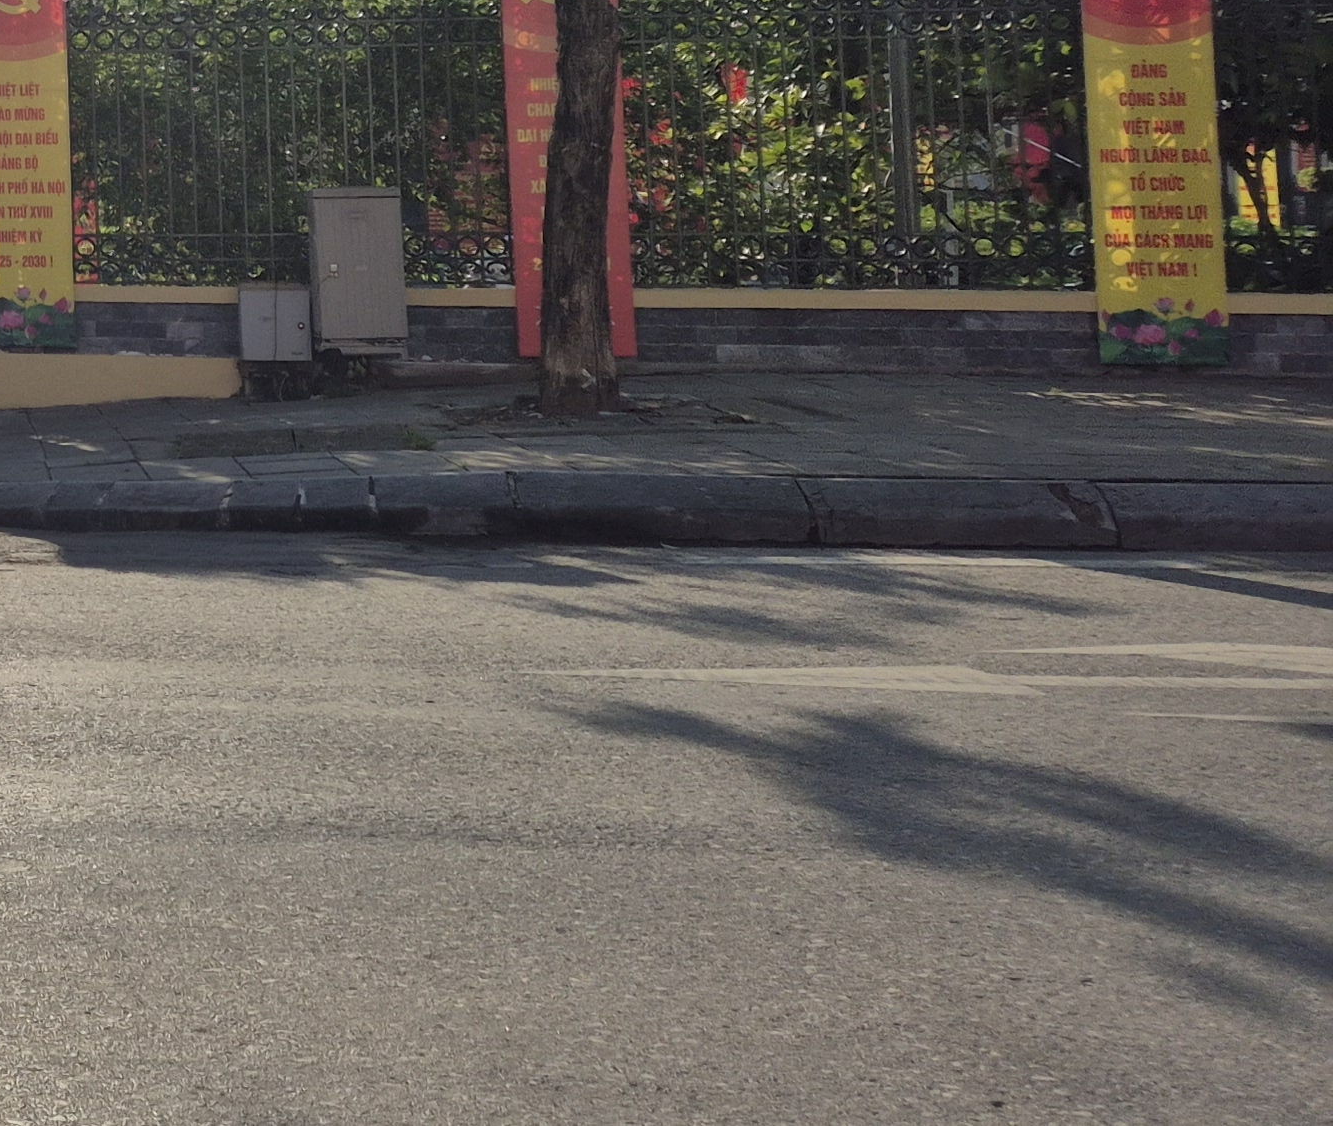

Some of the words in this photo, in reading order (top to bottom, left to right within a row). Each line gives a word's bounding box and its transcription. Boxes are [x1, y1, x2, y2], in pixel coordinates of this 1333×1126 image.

[1131, 58, 1167, 79] ĐẢNG
[19, 80, 41, 99] LIỆT
[530, 75, 560, 93] NHIỆ
[1119, 88, 1155, 110] CỘNG
[1159, 86, 1187, 107] SẢN
[14, 105, 46, 121] MỪNG
[1123, 116, 1150, 138] VIỆT
[1154, 120, 1185, 135] NAM
[15, 132, 33, 149] ĐẠI
[35, 127, 59, 145] BIỂU
[25, 154, 39, 173] BỘ
[1100, 145, 1141, 163] NGƯỜI
[1144, 145, 1178, 163] LÃNH
[7, 177, 28, 194] PHỐ
[31, 178, 45, 194] HÀ
[48, 178, 66, 197] NỘI
[1129, 170, 1146, 192] TỔ
[1150, 173, 1186, 192] CHỨC
[7, 203, 28, 219] THỨ
[30, 206, 53, 219] XVIII
[1111, 205, 1136, 223] MỌI
[1140, 201, 1183, 220] THẮNG
[1187, 204, 1208, 224] LỢI
[29, 227, 43, 243] KỲ
[1104, 228, 1131, 248] CỦA
[1135, 230, 1170, 249] CÁCH
[1174, 233, 1214, 252] MẠNG
[22, 255, 47, 268] 2030
[1126, 259, 1154, 280] VIỆT
[1157, 262, 1189, 277] NAM
[1193, 262, 1198, 277] !
